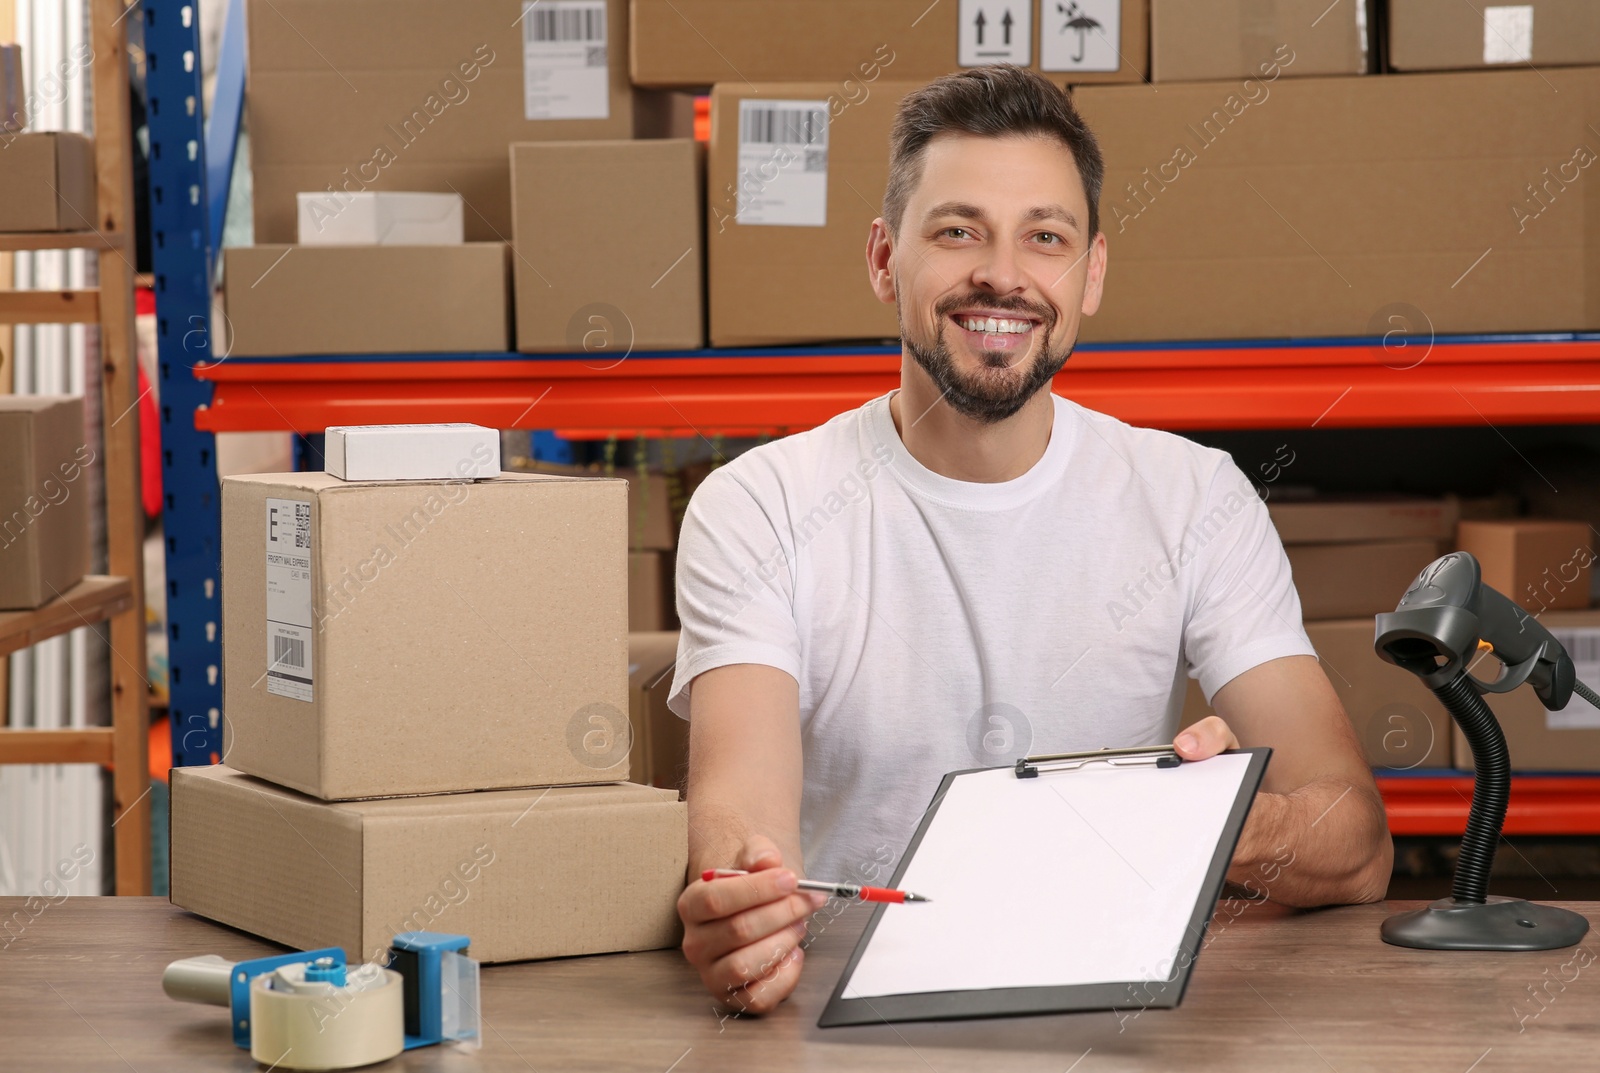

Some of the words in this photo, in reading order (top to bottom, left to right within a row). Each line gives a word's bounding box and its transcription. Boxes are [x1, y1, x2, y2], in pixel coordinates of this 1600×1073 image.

[270, 508, 278, 541] E
[267, 554, 283, 565] PRIORITY
[292, 558, 309, 568] EXPRESS
